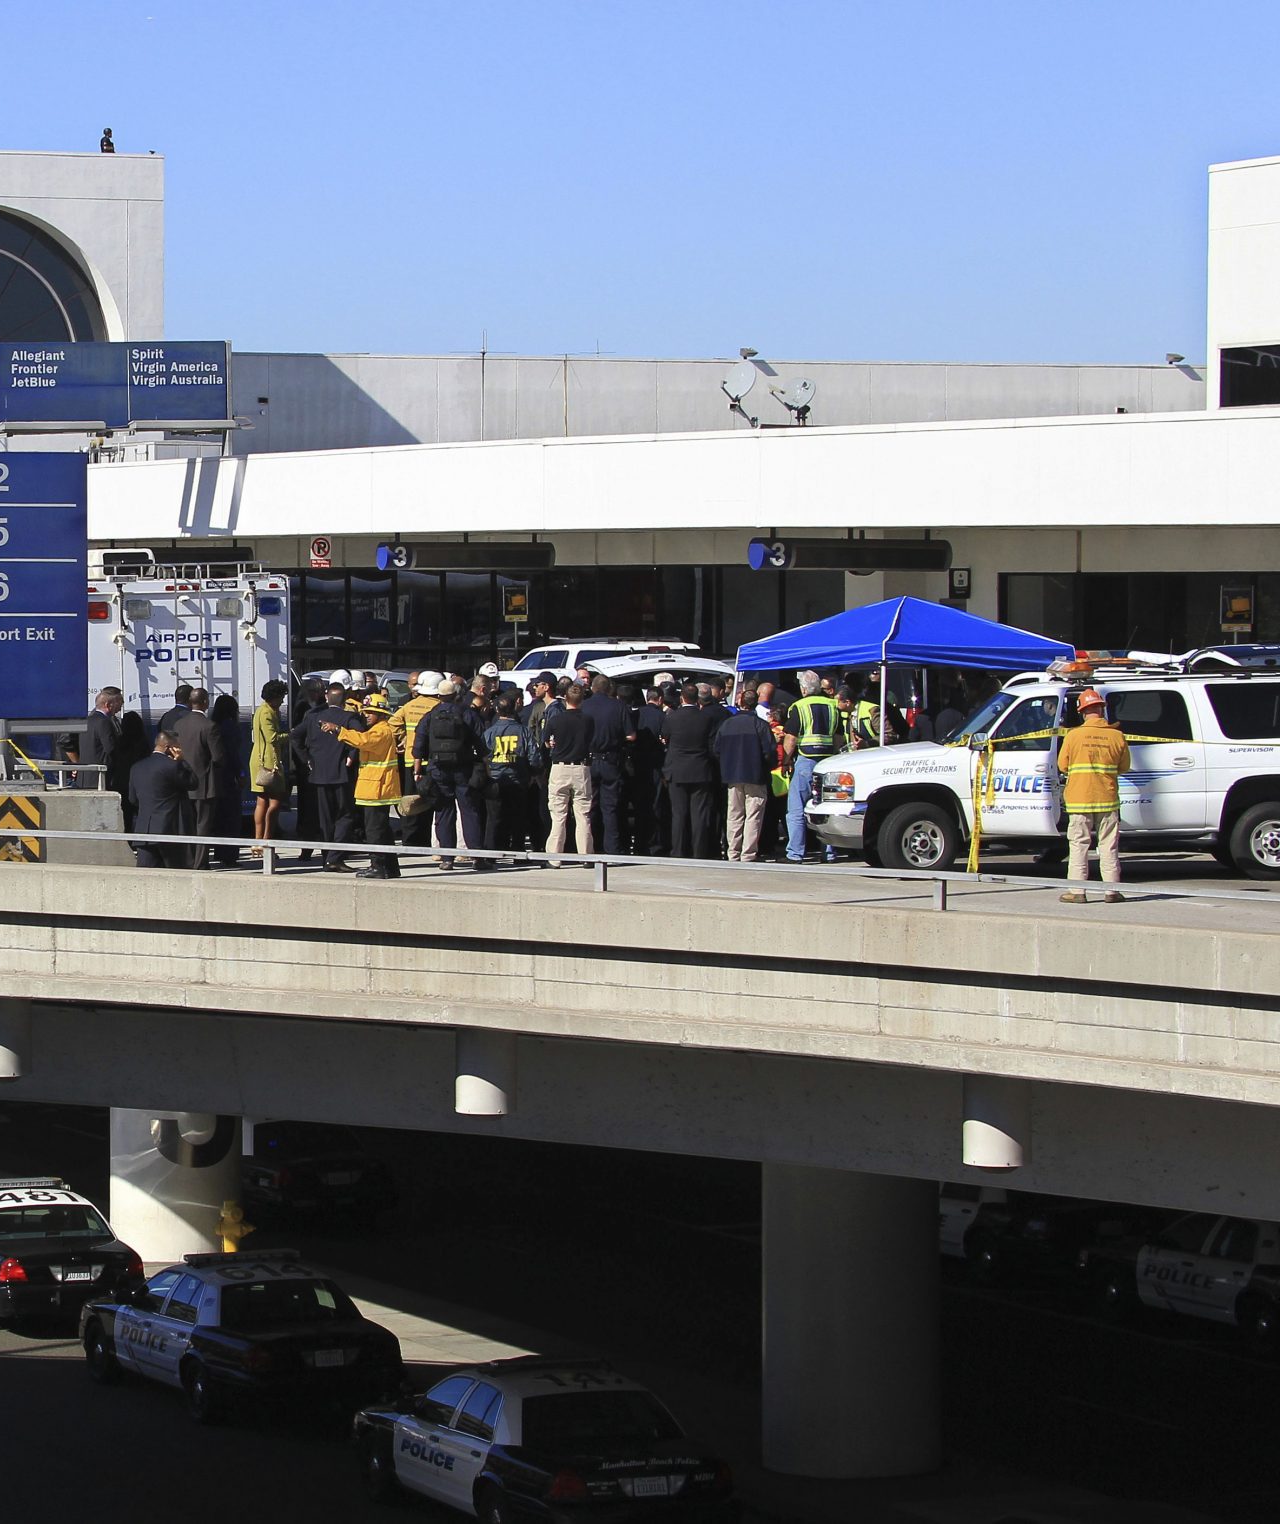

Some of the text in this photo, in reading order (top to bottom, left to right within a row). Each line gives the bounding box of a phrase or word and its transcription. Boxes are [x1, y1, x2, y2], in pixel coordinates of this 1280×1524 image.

[11, 350, 65, 363] Allegiant
[132, 348, 164, 361] Spirit
[11, 363, 58, 374] Frontier
[132, 361, 218, 375] Virgin America
[11, 376, 57, 388] JetBlue
[132, 374, 224, 388] Virgin Australia
[393, 546, 407, 567] 3
[769, 542, 786, 567] 3
[25, 627, 56, 641] Exit
[146, 633, 223, 644] AIRPORT
[135, 647, 233, 664] POLICE
[494, 735, 518, 755] ATF
[902, 759, 930, 767] TRAFFIC
[881, 765, 957, 776] SECURITY OPERATIONS
[219, 1263, 313, 1281] 614
[1143, 1262, 1215, 1290] POLICE
[120, 1324, 168, 1354] POLICE
[401, 1438, 456, 1472] POLICE
